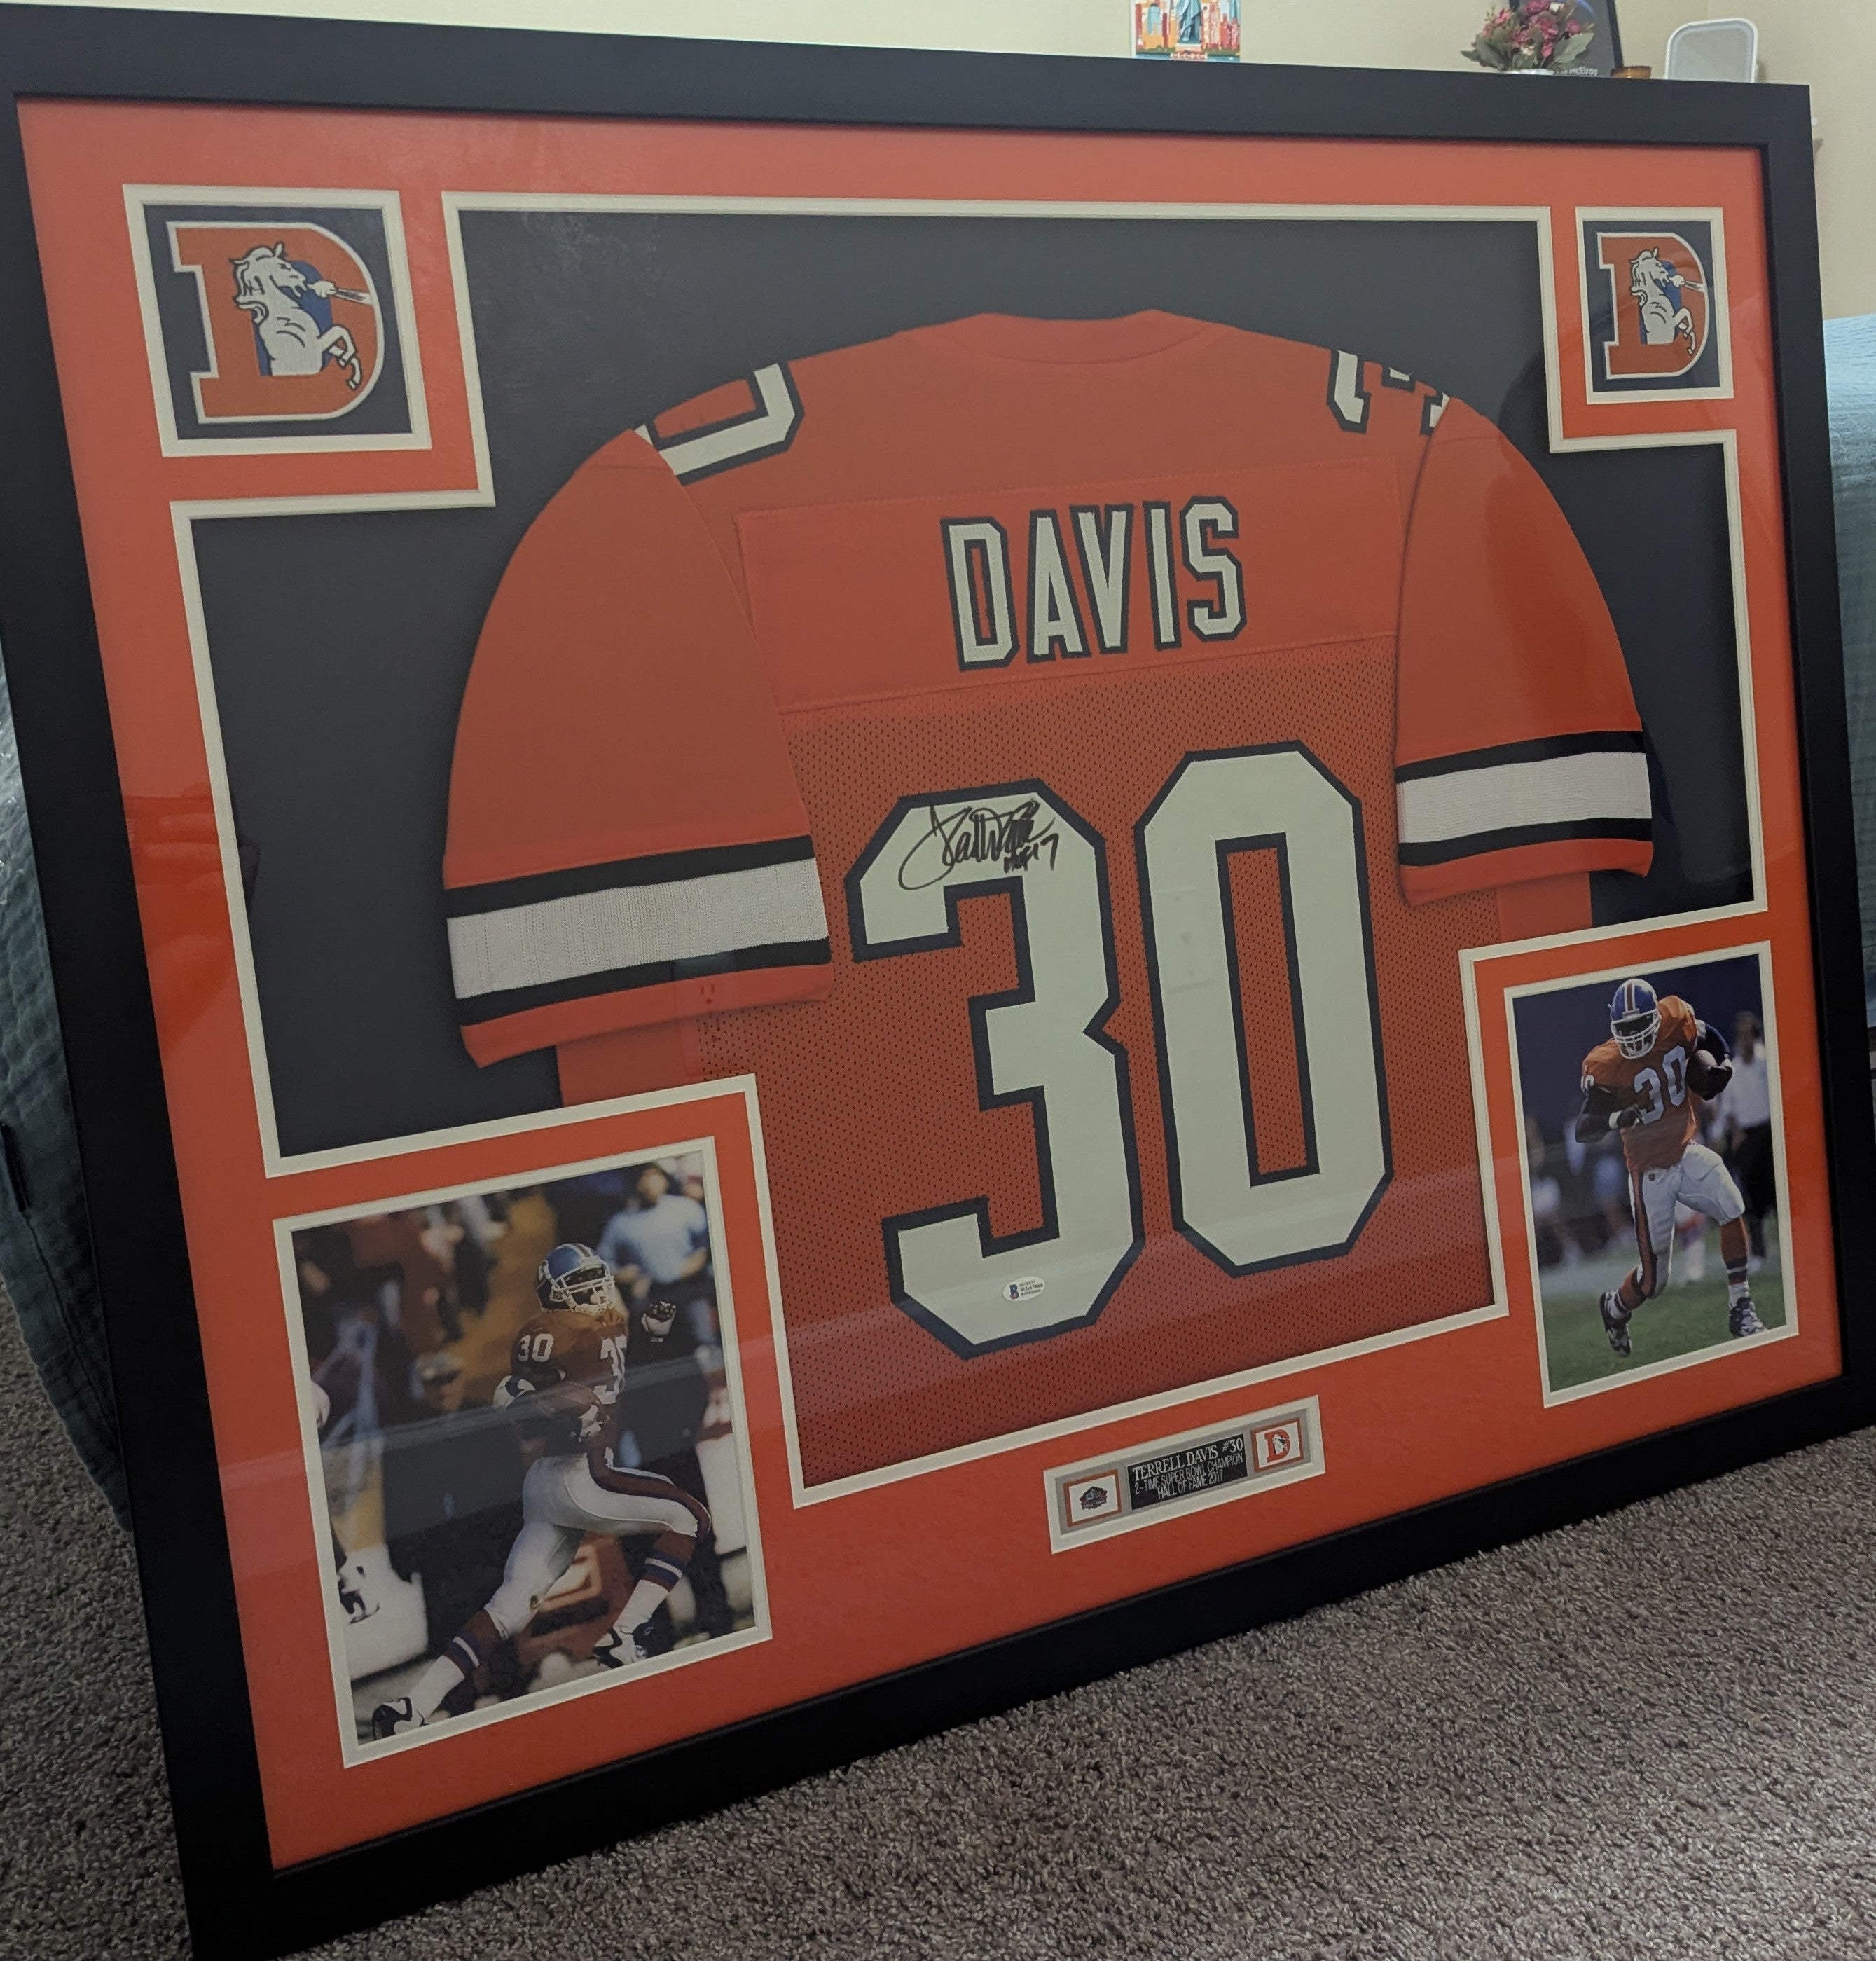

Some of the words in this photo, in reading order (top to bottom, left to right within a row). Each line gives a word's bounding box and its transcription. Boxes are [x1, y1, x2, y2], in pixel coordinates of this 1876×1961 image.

[940, 495, 1247, 672] DAVIS
[845, 739, 1394, 1361] 30
[1634, 1045, 1686, 1124] 30
[518, 1333, 555, 1363] 30
[1132, 1454, 1185, 1482] TERRELL
[1187, 1444, 1218, 1466] DAVIS
[1222, 1437, 1243, 1454] #30
[1161, 1468, 1186, 1487] SUPER
[1186, 1464, 1206, 1480] BOWL
[1206, 1452, 1243, 1473] CHAMPION
[1157, 1483, 1178, 1500] HALL
[1178, 1478, 1188, 1494] OF
[1188, 1472, 1208, 1490] FAME
[1208, 1469, 1224, 1485] 2017
